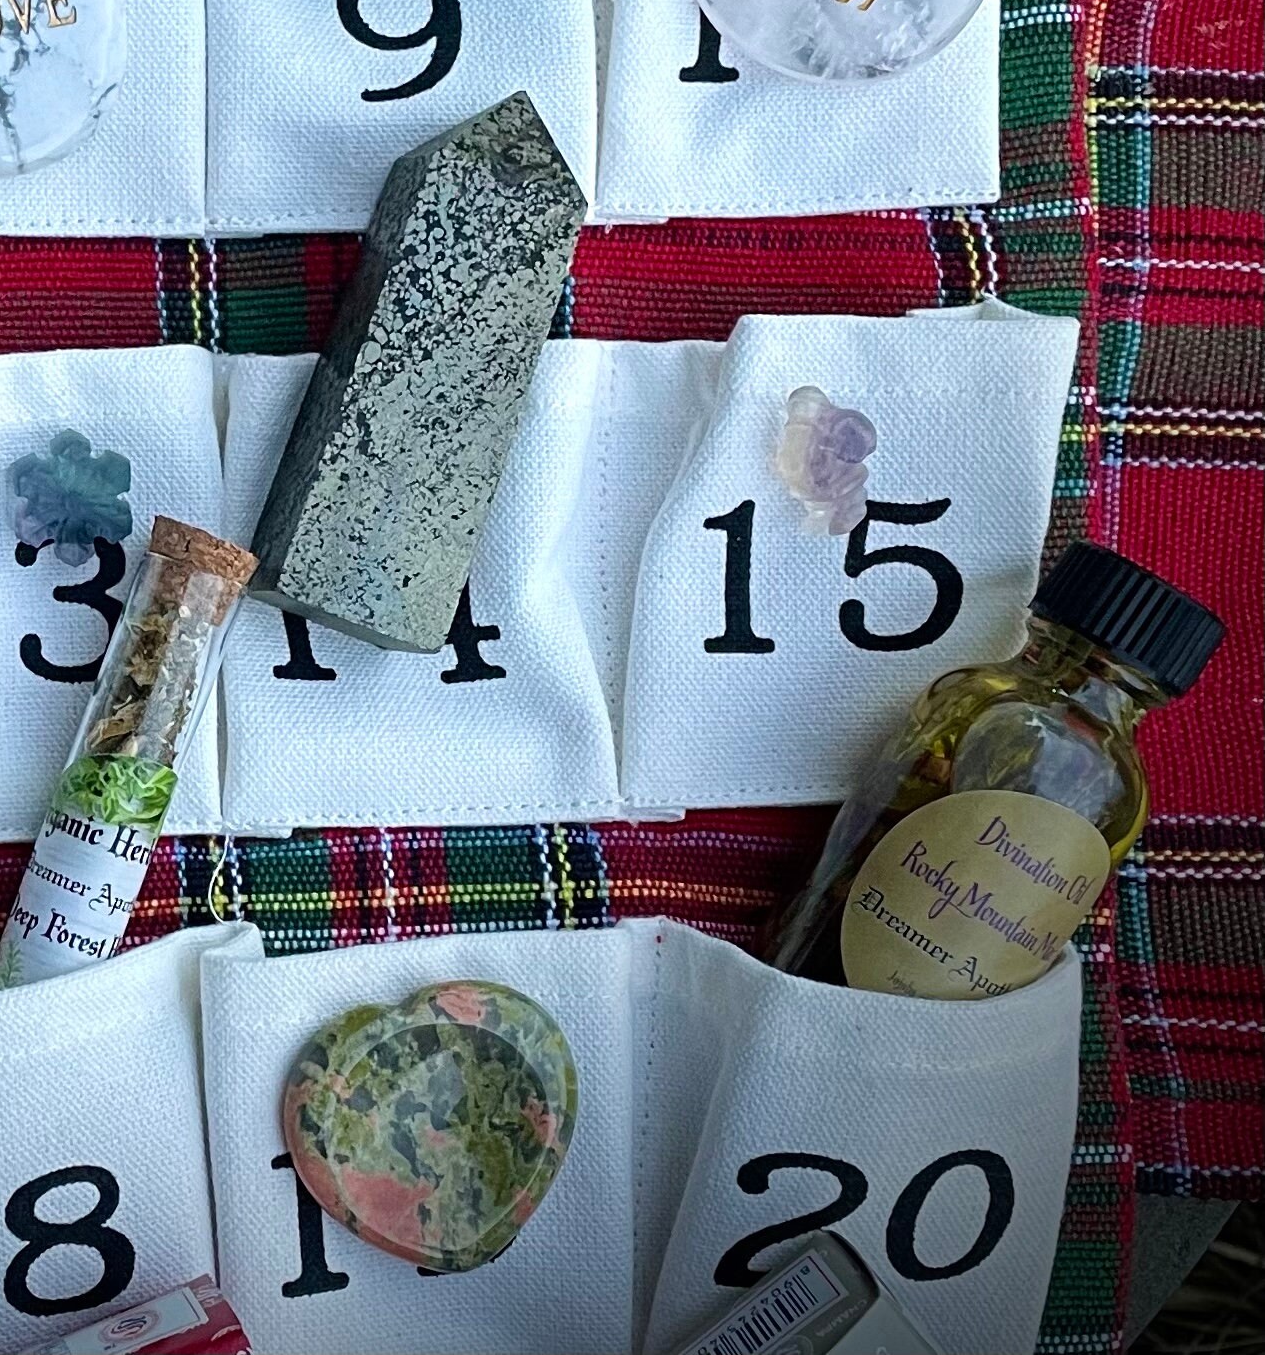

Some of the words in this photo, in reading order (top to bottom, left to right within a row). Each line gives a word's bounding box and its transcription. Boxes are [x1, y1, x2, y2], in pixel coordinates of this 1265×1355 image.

[702, 497, 964, 654] 15
[45, 809, 105, 846] ganic
[974, 815, 1068, 896] Divination
[40, 906, 108, 960] Forest
[851, 886, 954, 966] Dreamer
[899, 839, 974, 920] Rocky
[957, 882, 1039, 956] Mountain
[712, 1148, 1015, 1288] 20
